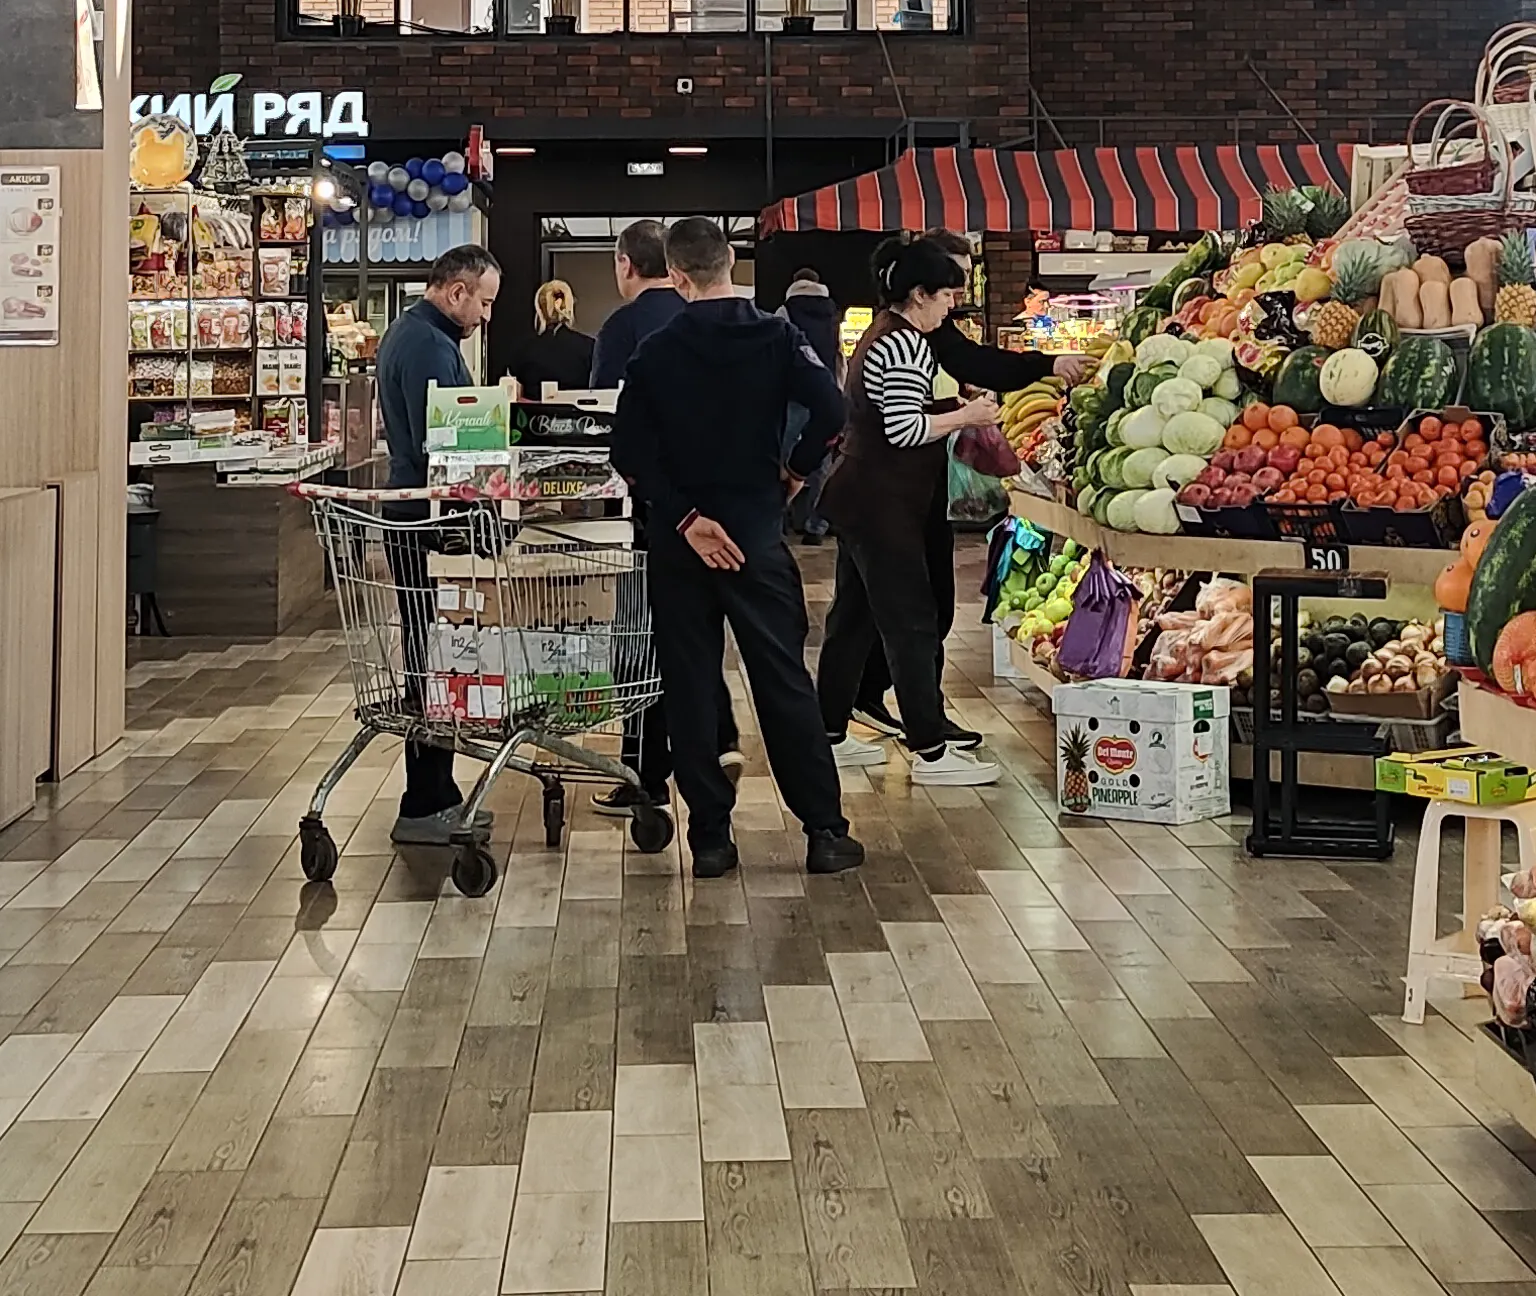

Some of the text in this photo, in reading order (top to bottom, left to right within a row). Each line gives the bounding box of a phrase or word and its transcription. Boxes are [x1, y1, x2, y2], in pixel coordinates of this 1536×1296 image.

[253, 91, 368, 138] РЯД
[9, 175, 42, 184] АКЦИЯ
[542, 481, 583, 496] DELUXE
[1311, 548, 1341, 570] 50
[1100, 777, 1129, 787] GOLD
[1092, 786, 1139, 806] PINEAPPLE
